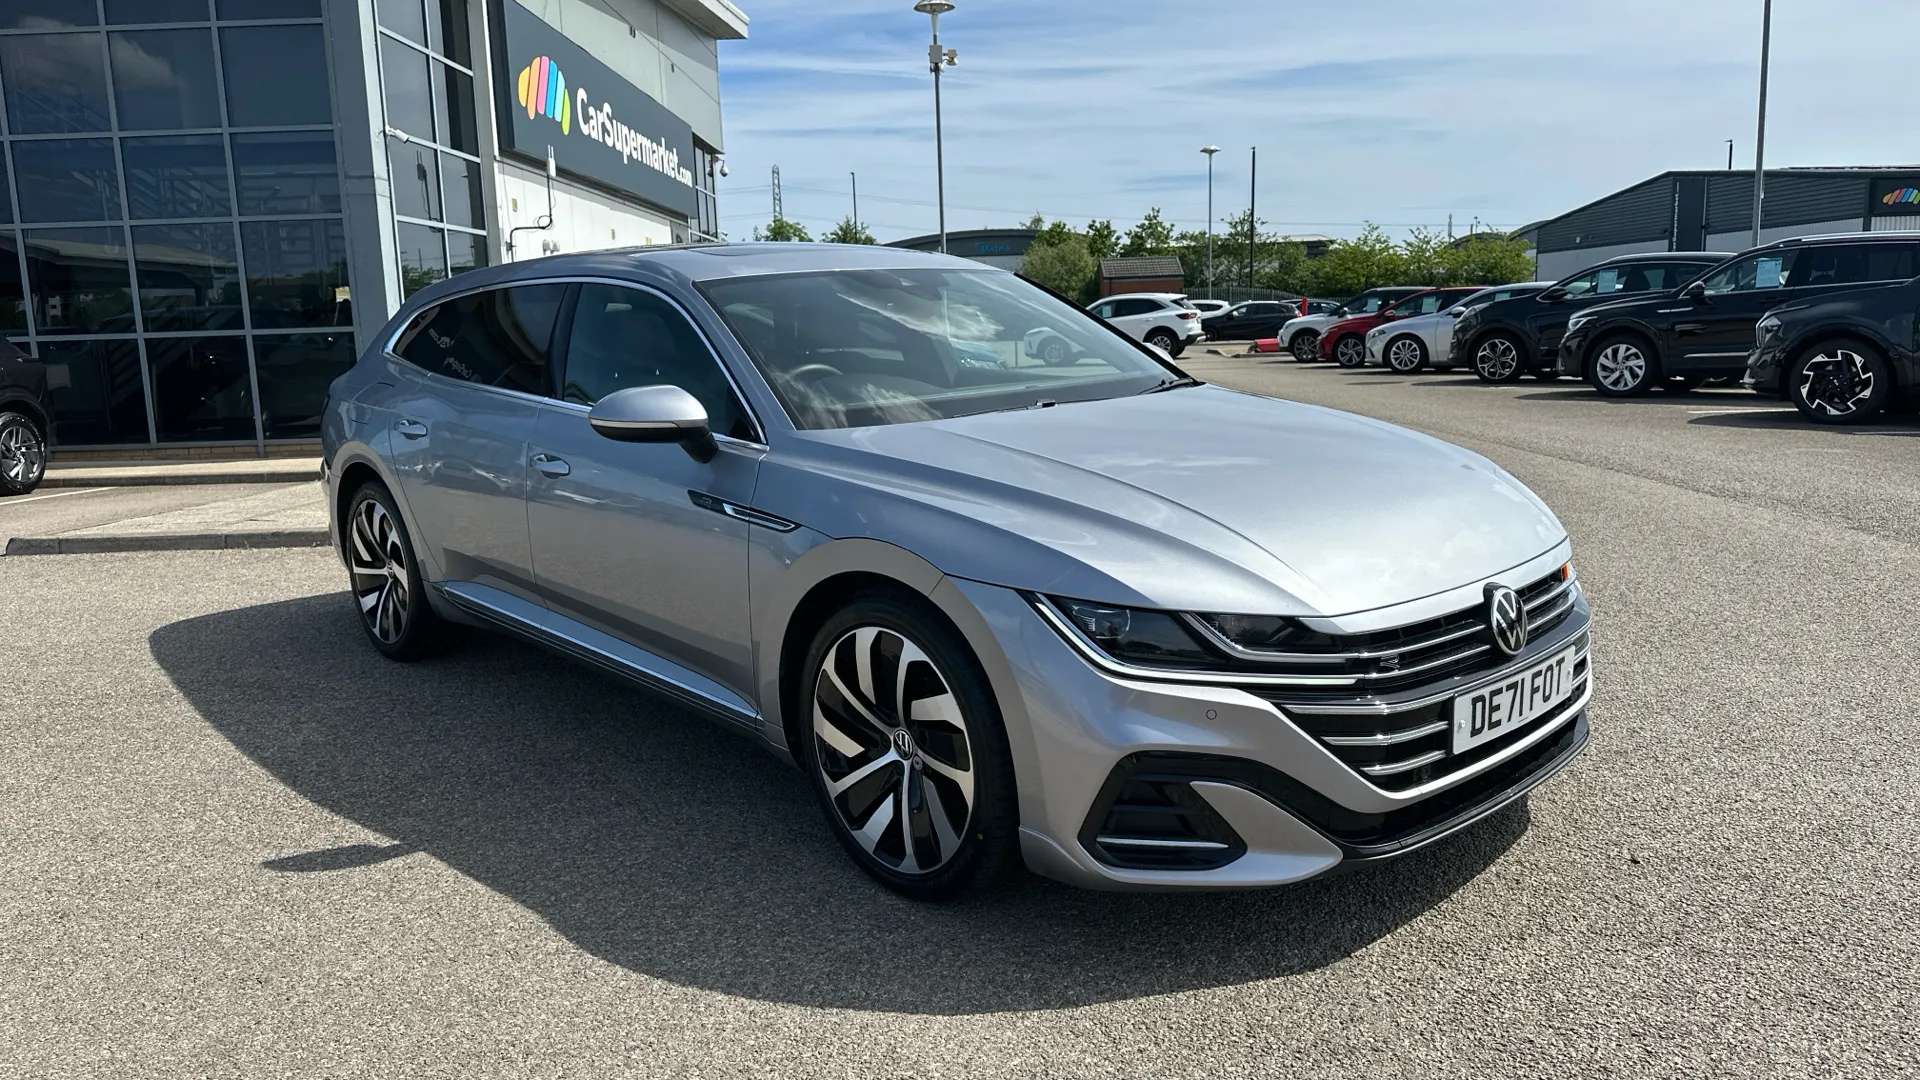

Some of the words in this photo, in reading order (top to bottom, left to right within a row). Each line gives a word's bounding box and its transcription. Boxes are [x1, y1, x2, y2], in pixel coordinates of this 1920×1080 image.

[576, 88, 693, 188] CarSupermarket.com
[1470, 678, 1525, 738] DE71
[1530, 657, 1566, 712] FOT
